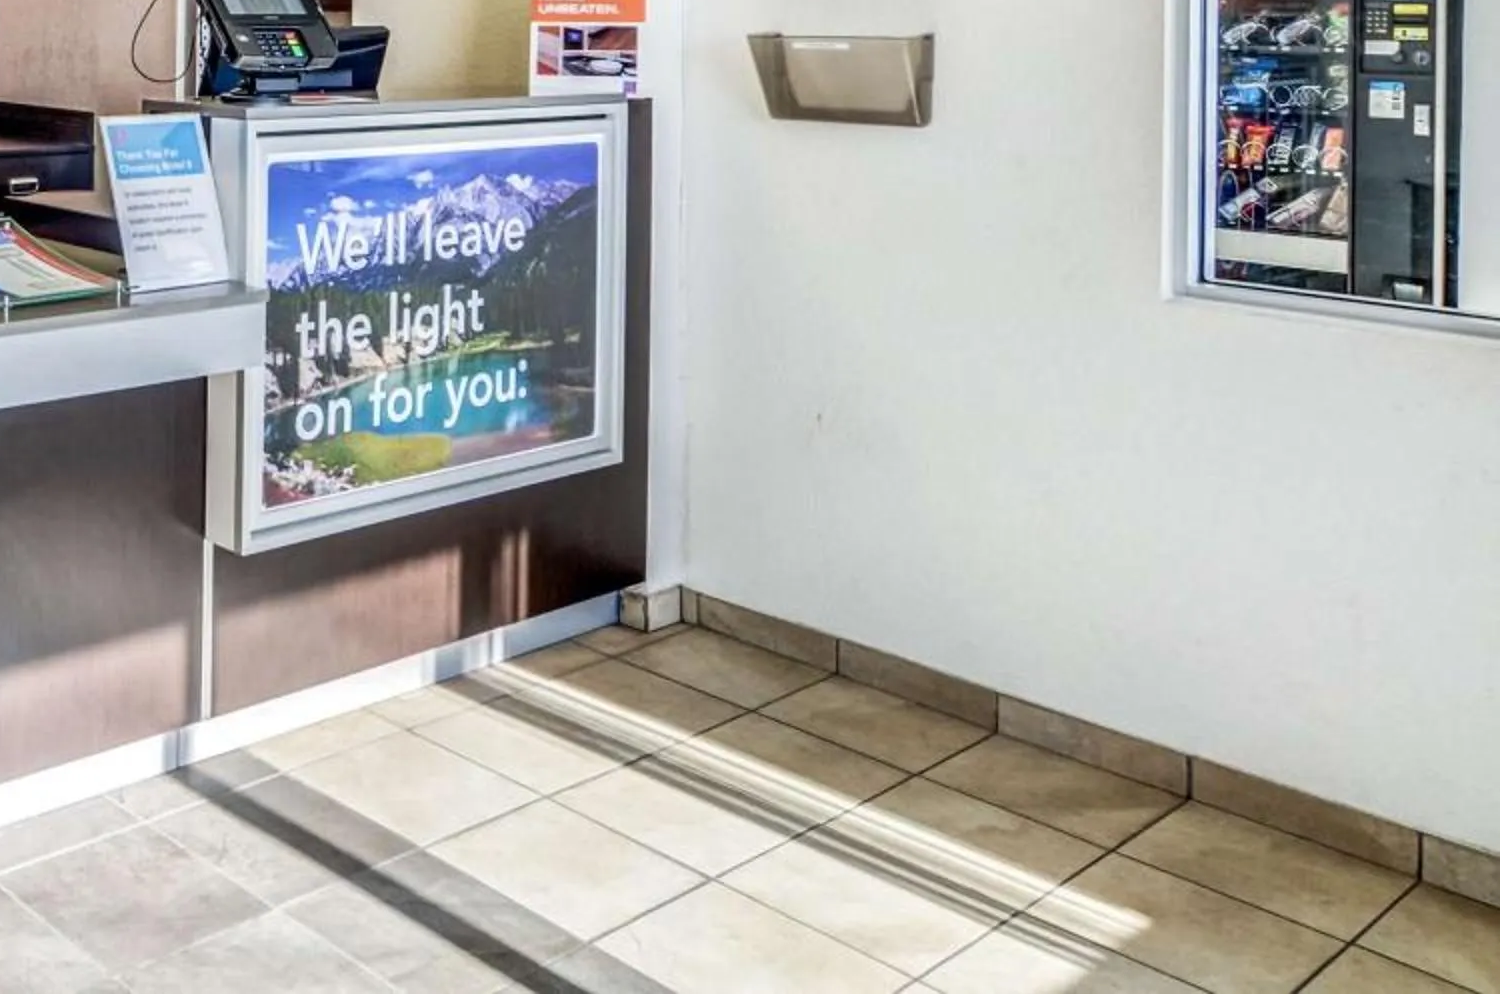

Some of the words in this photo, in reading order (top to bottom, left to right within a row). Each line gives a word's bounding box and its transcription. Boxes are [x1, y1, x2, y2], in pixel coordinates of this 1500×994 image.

[538, 3, 620, 15] UNBEATEN.
[296, 210, 407, 275] We'll
[422, 209, 526, 262] leave
[295, 300, 372, 359] the
[389, 283, 485, 357] light
[295, 398, 352, 442] on
[369, 374, 433, 428] for
